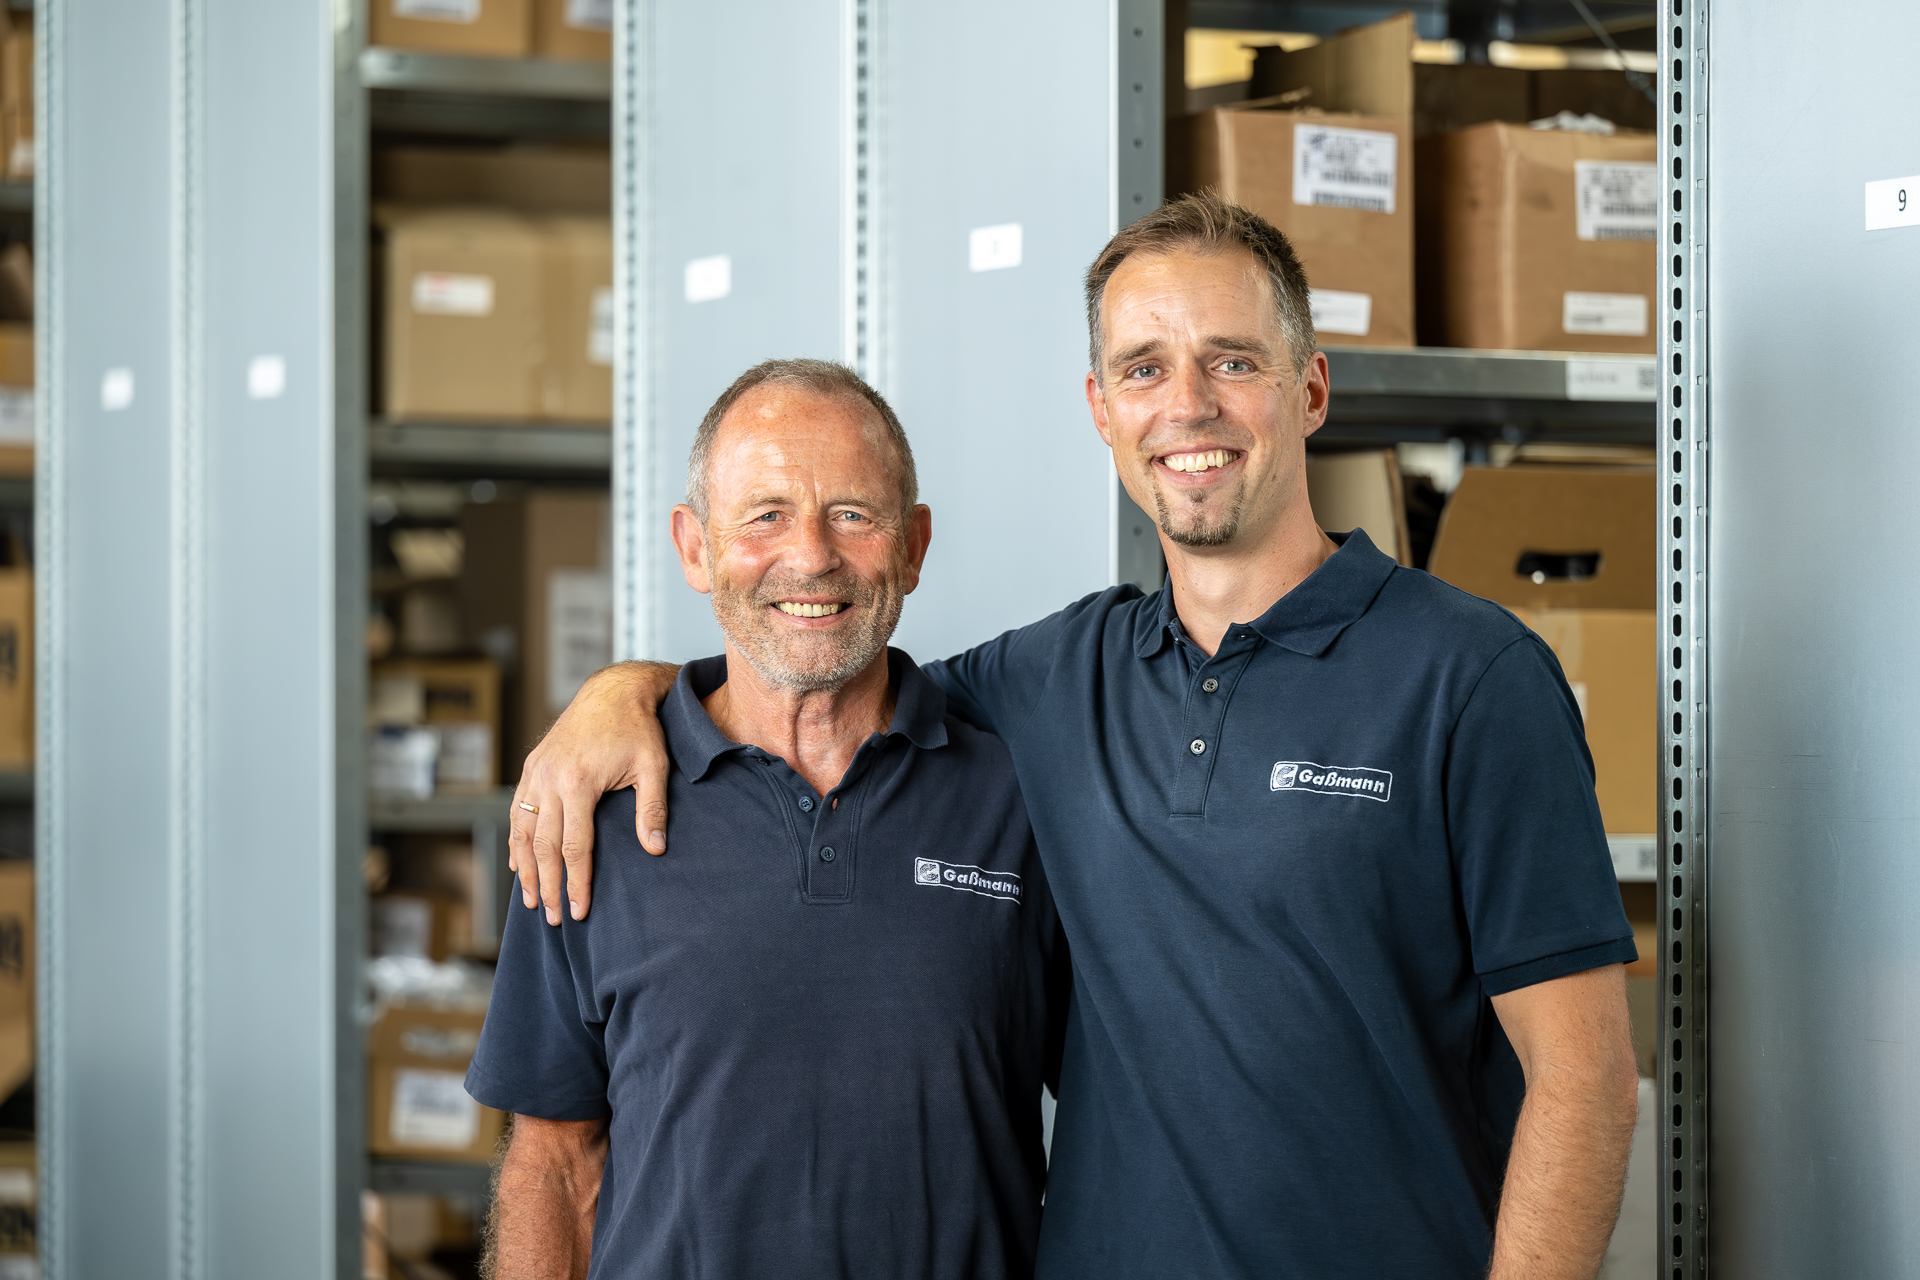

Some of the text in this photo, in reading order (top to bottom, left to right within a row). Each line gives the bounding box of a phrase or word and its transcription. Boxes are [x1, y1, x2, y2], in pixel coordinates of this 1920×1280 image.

[1898, 189, 1907, 212] 9
[1298, 768, 1385, 793] Gaßmann
[943, 868, 1020, 896] Gaßmann
